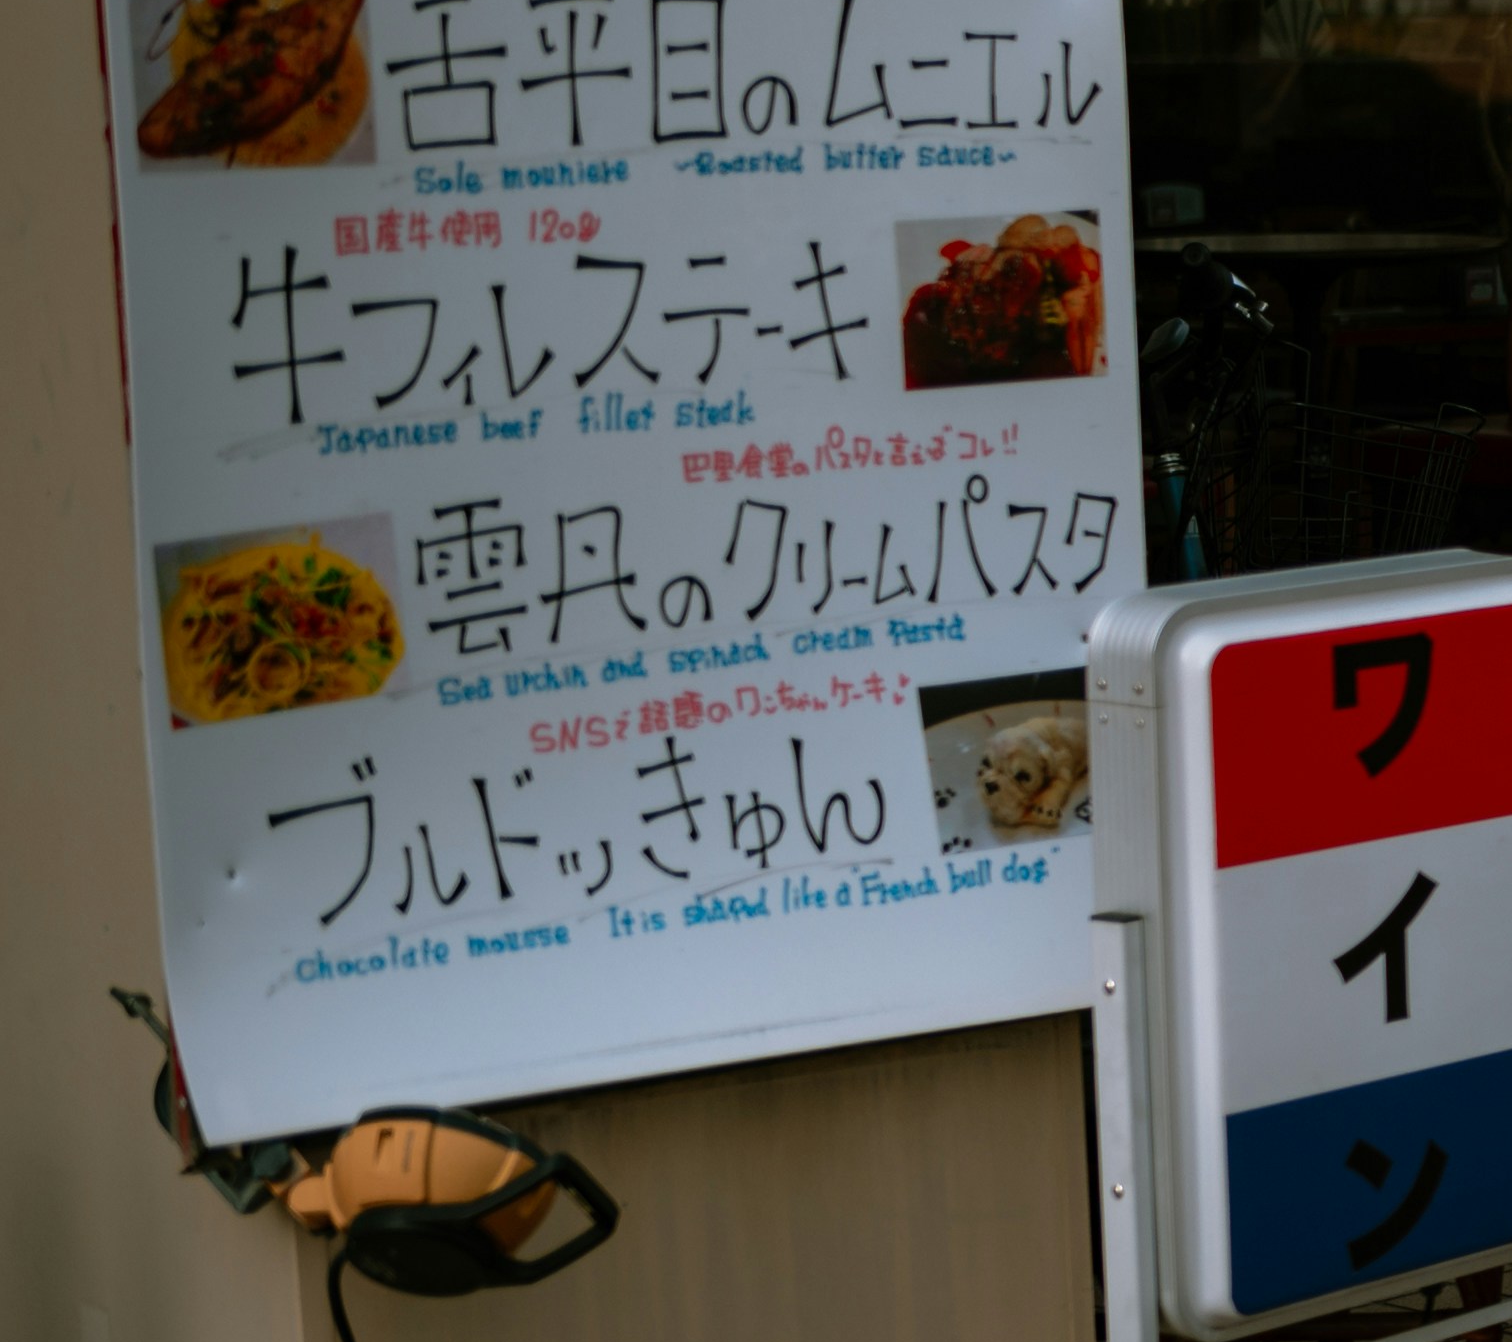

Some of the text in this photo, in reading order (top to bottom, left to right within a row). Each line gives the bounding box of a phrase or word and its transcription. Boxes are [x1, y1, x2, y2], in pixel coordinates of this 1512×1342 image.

[413, 160, 483, 195] Sole
[334, 211, 502, 257] 国産牛使用
[232, 242, 868, 422] 牛フィレステーキ
[480, 408, 543, 443] beef
[676, 392, 757, 430] steak
[414, 472, 1118, 655] 雲丹のクリームパスタ
[437, 675, 493, 709] Sea
[268, 736, 887, 927] ブルドッきゅん
[467, 920, 571, 961] mousse
[782, 875, 828, 914] like
[947, 856, 993, 894] bull
[1332, 632, 1449, 1273] ワイン
